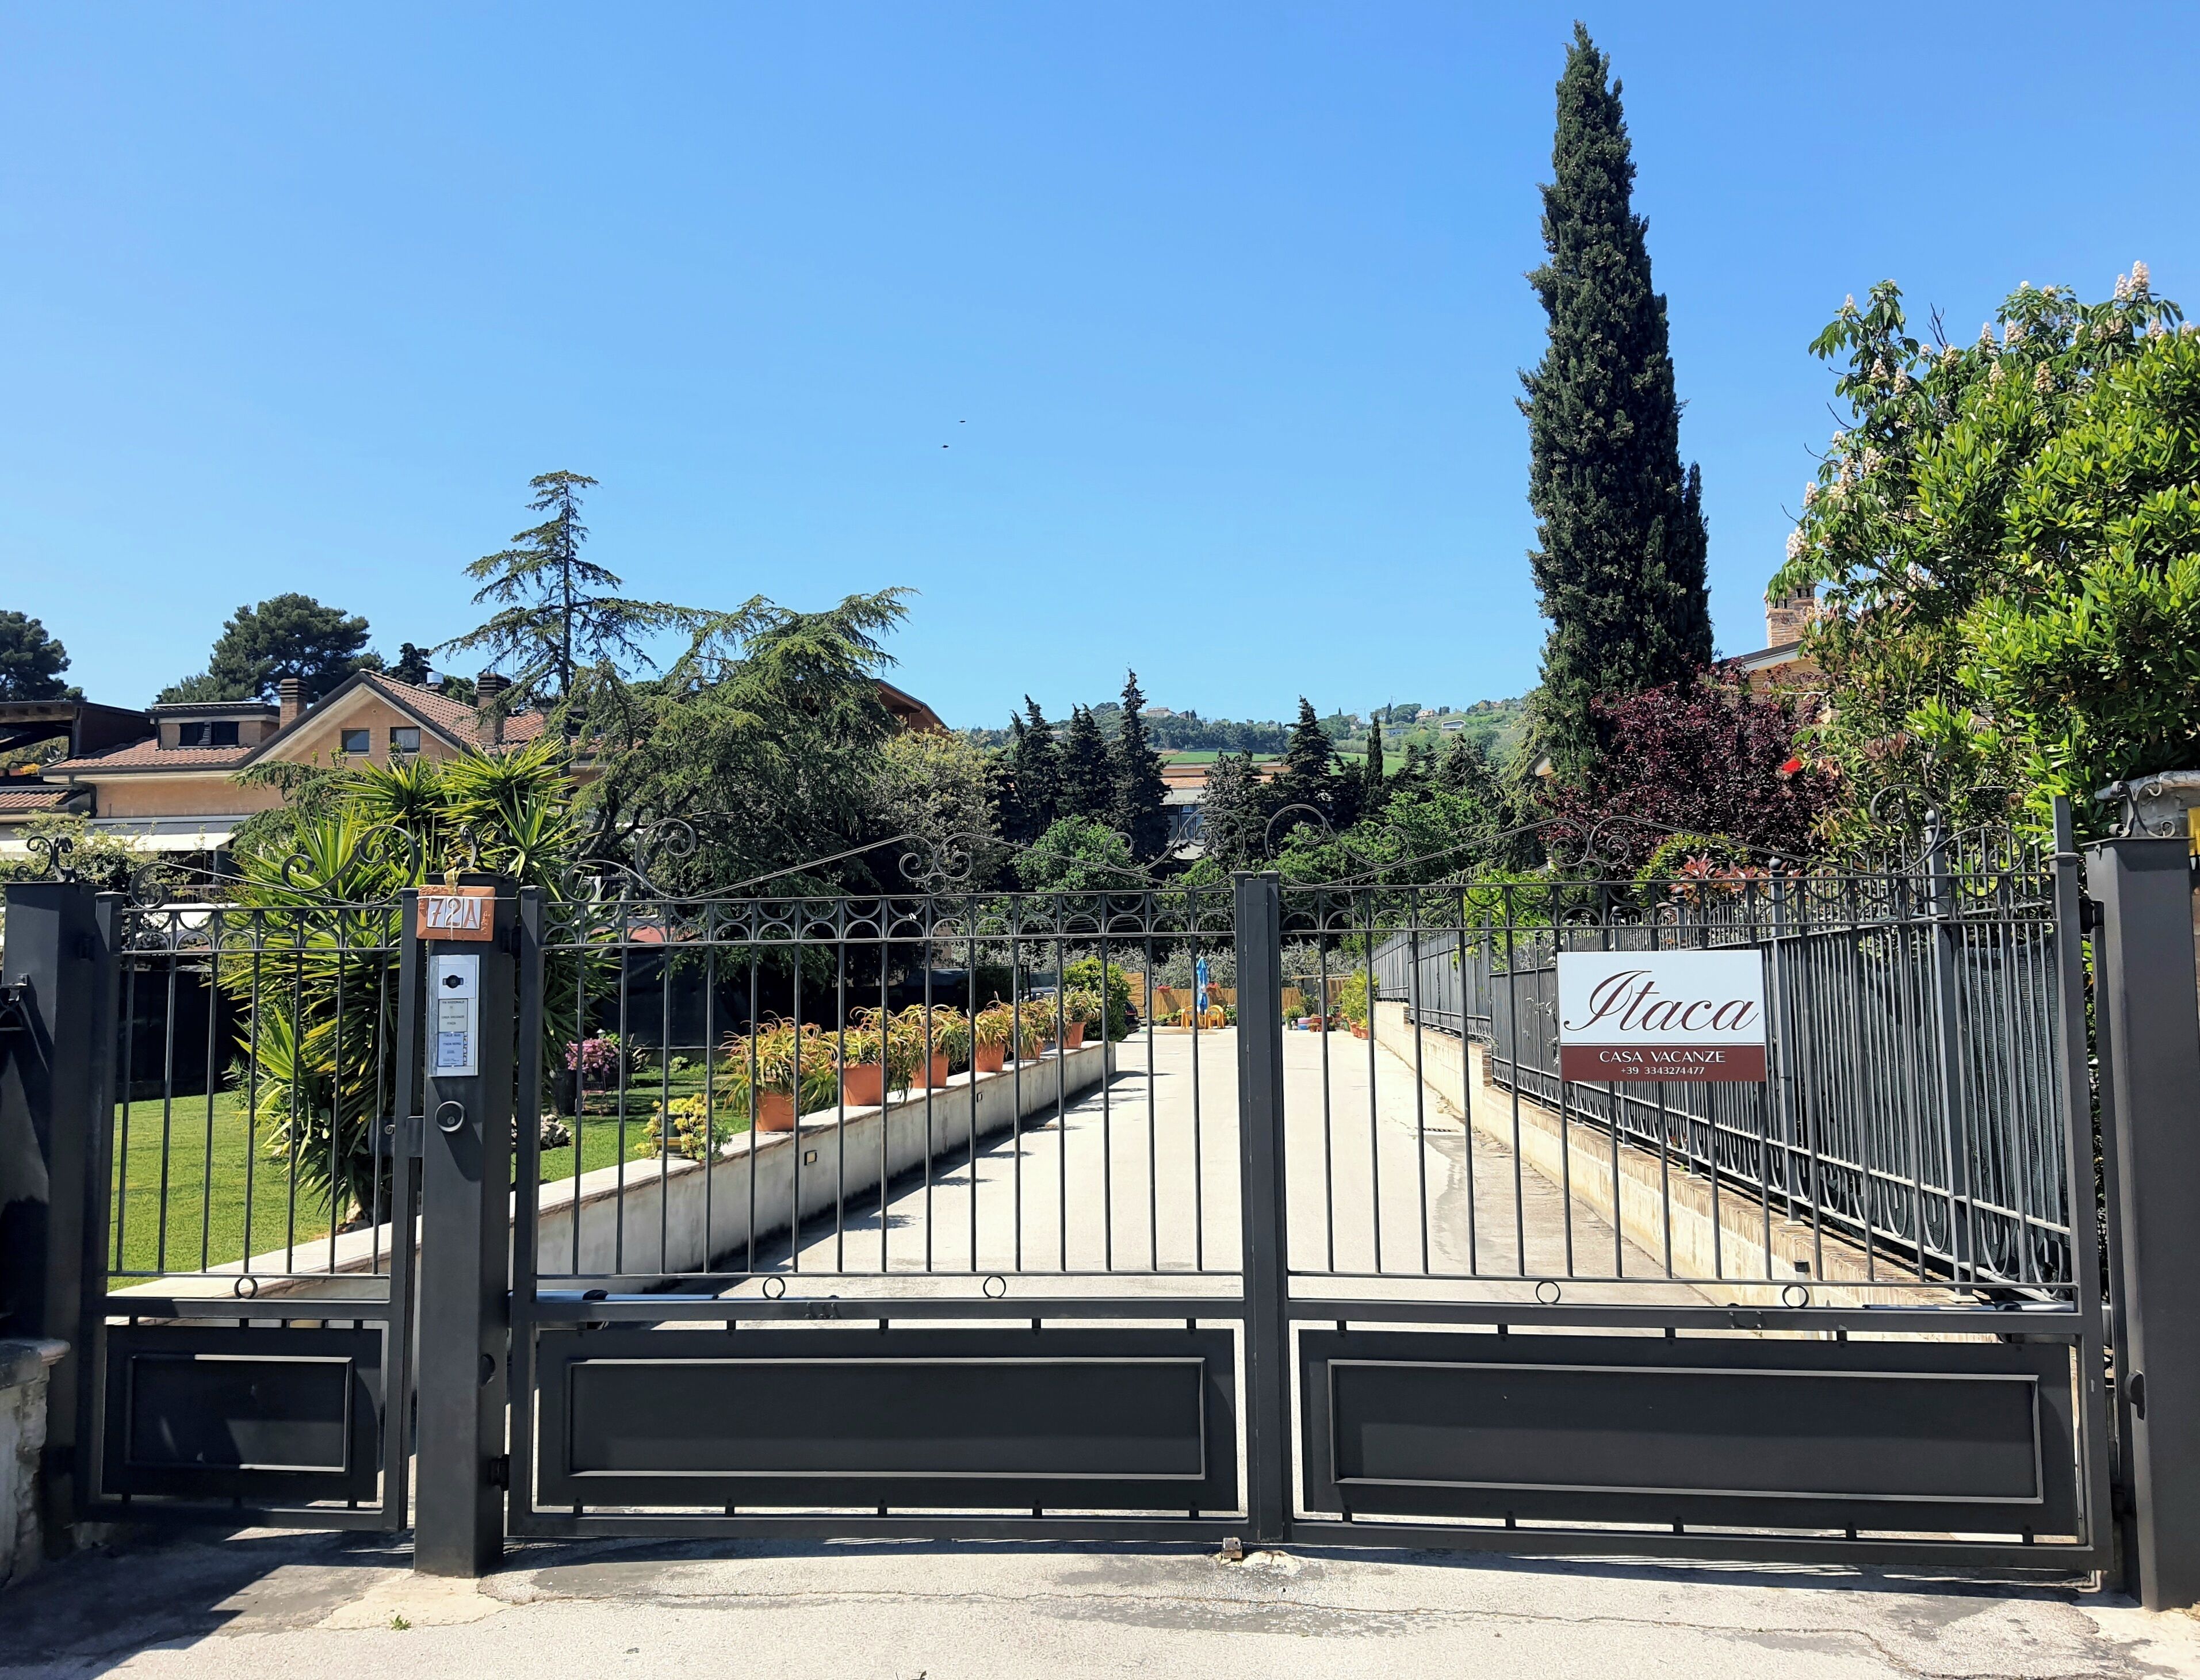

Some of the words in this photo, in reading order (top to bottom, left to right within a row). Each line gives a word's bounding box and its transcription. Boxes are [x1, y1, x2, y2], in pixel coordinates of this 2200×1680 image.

[430, 898, 478, 928] 72A
[1563, 970, 1759, 1031] Itaca
[1599, 1051, 1643, 1063] CASA
[1650, 1051, 1725, 1063] VACANZE
[1621, 1066, 1639, 1074] +39
[1644, 1066, 1705, 1074] 3343274477
